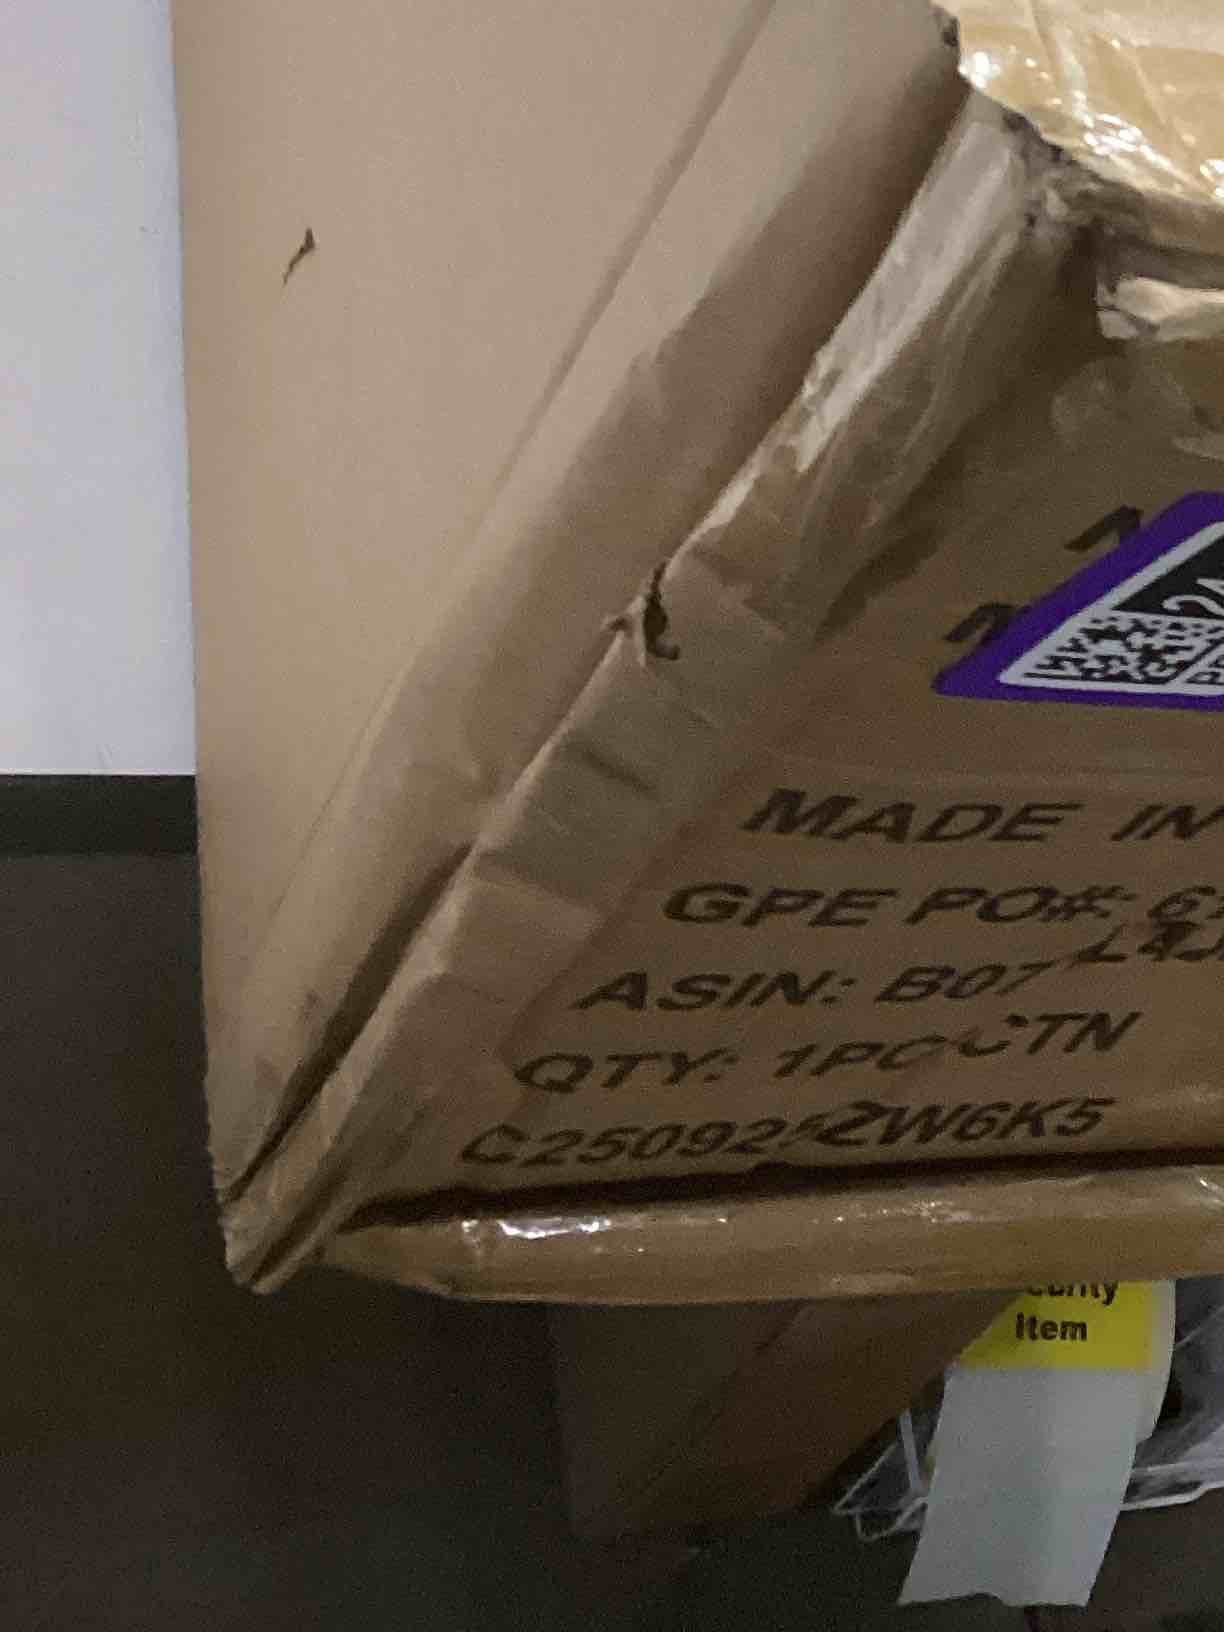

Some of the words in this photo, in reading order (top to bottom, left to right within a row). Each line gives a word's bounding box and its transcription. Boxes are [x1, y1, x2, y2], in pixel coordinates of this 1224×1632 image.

[740, 786, 1089, 844] MADE
[662, 882, 901, 928] GPE
[567, 968, 857, 1013] ASIN:
[513, 1048, 738, 1096] QTY:
